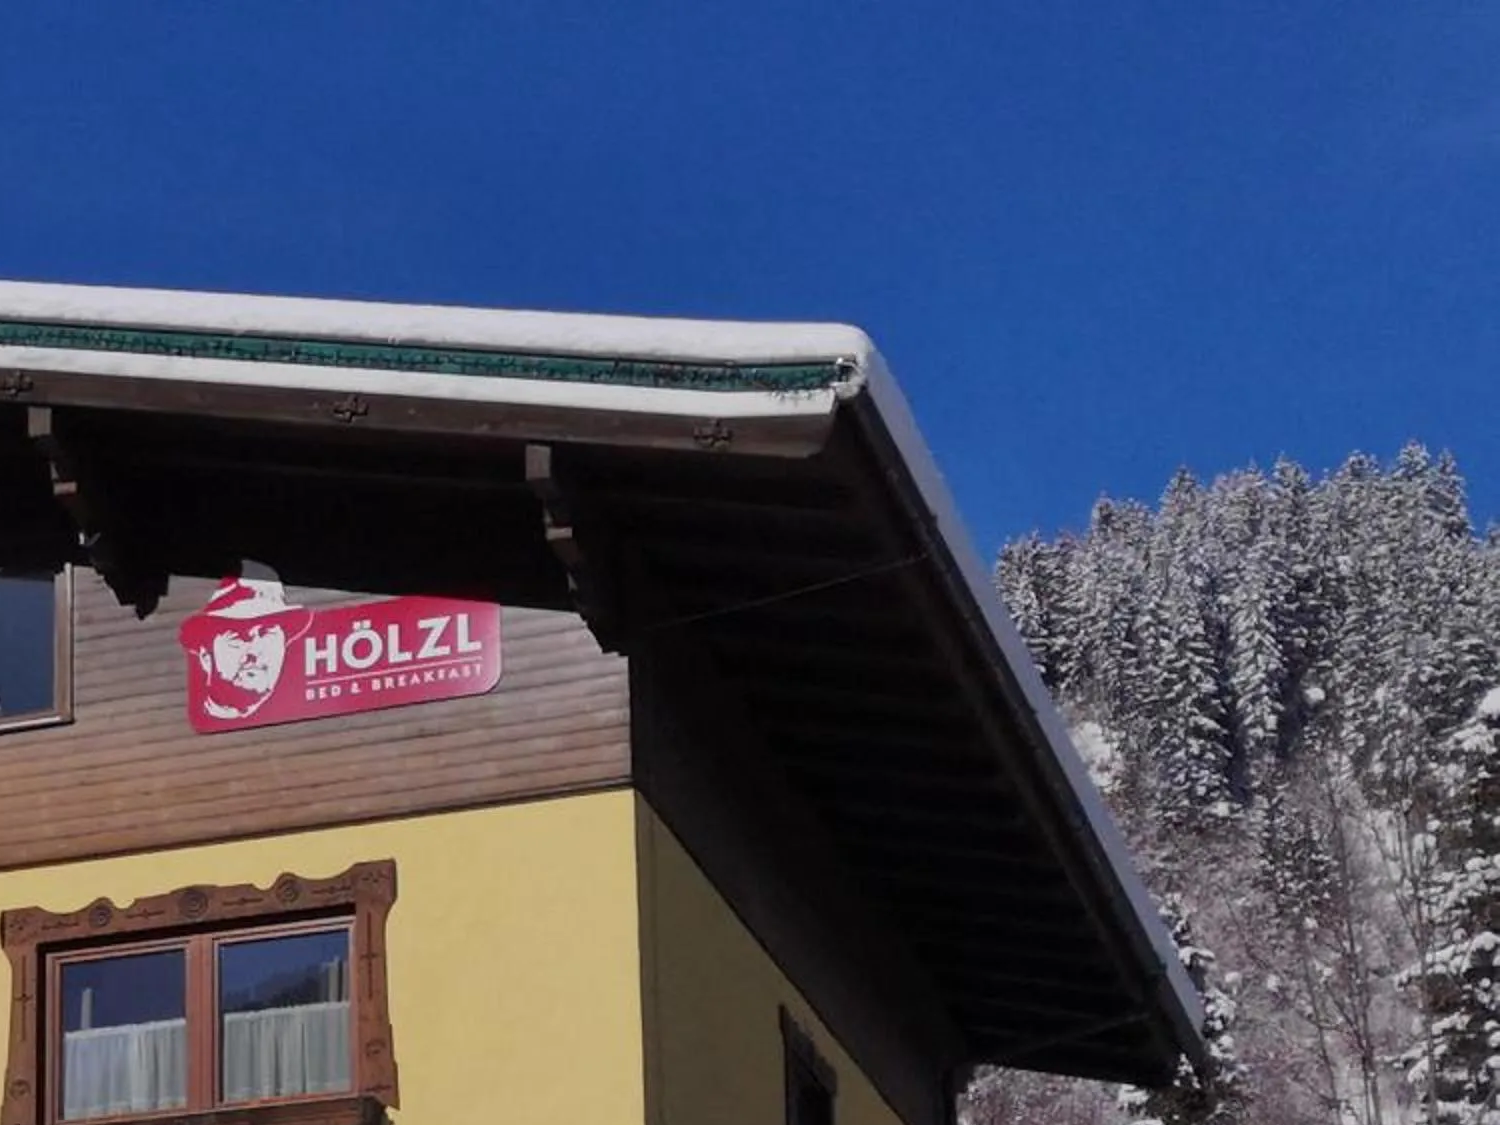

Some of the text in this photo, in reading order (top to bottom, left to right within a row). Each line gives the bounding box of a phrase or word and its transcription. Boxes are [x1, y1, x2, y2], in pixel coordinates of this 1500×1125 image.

[305, 613, 481, 676] HÖLZL
[305, 664, 483, 700] BED & BREAKFAST
